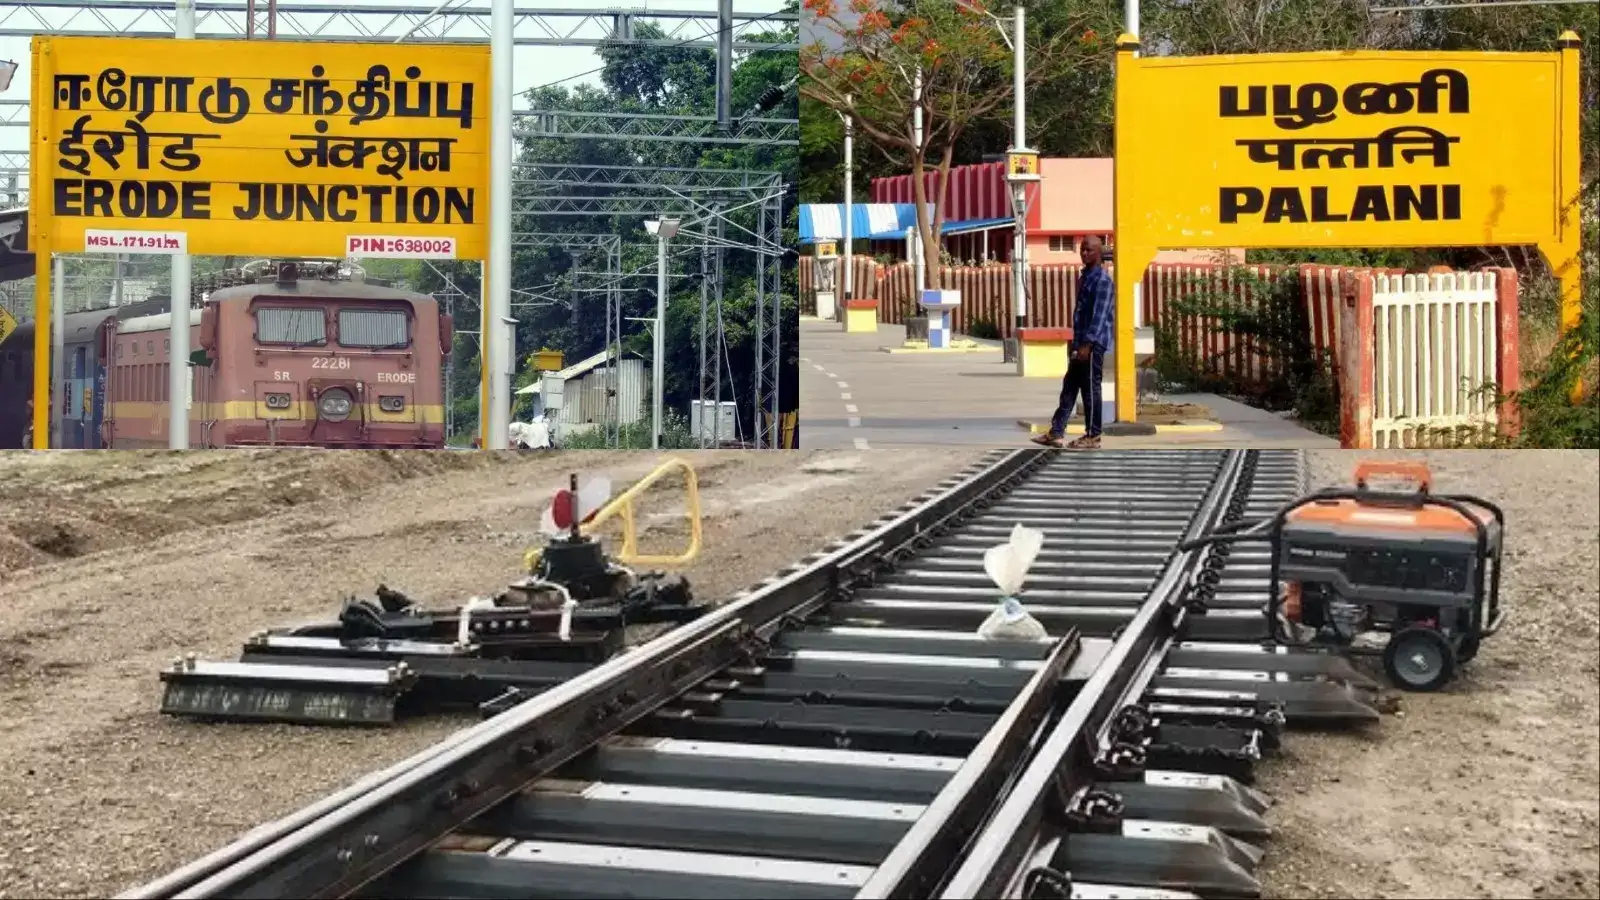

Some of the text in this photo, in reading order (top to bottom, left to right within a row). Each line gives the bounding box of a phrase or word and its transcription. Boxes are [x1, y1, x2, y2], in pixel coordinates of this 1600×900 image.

[54, 64, 474, 129] ஈரோடு சந்திப்பு
[1219, 68, 1469, 130] பழனி
[58, 114, 458, 181] ईरोड जंक्शन
[1235, 126, 1460, 171] पलनि
[53, 178, 474, 224] ERODE JUNCTION
[1219, 184, 1461, 223] PALANI
[349, 238, 451, 253] PIN:638002
[273, 371, 291, 381] SR
[311, 357, 351, 370] 22281
[377, 372, 416, 383] ERODE
